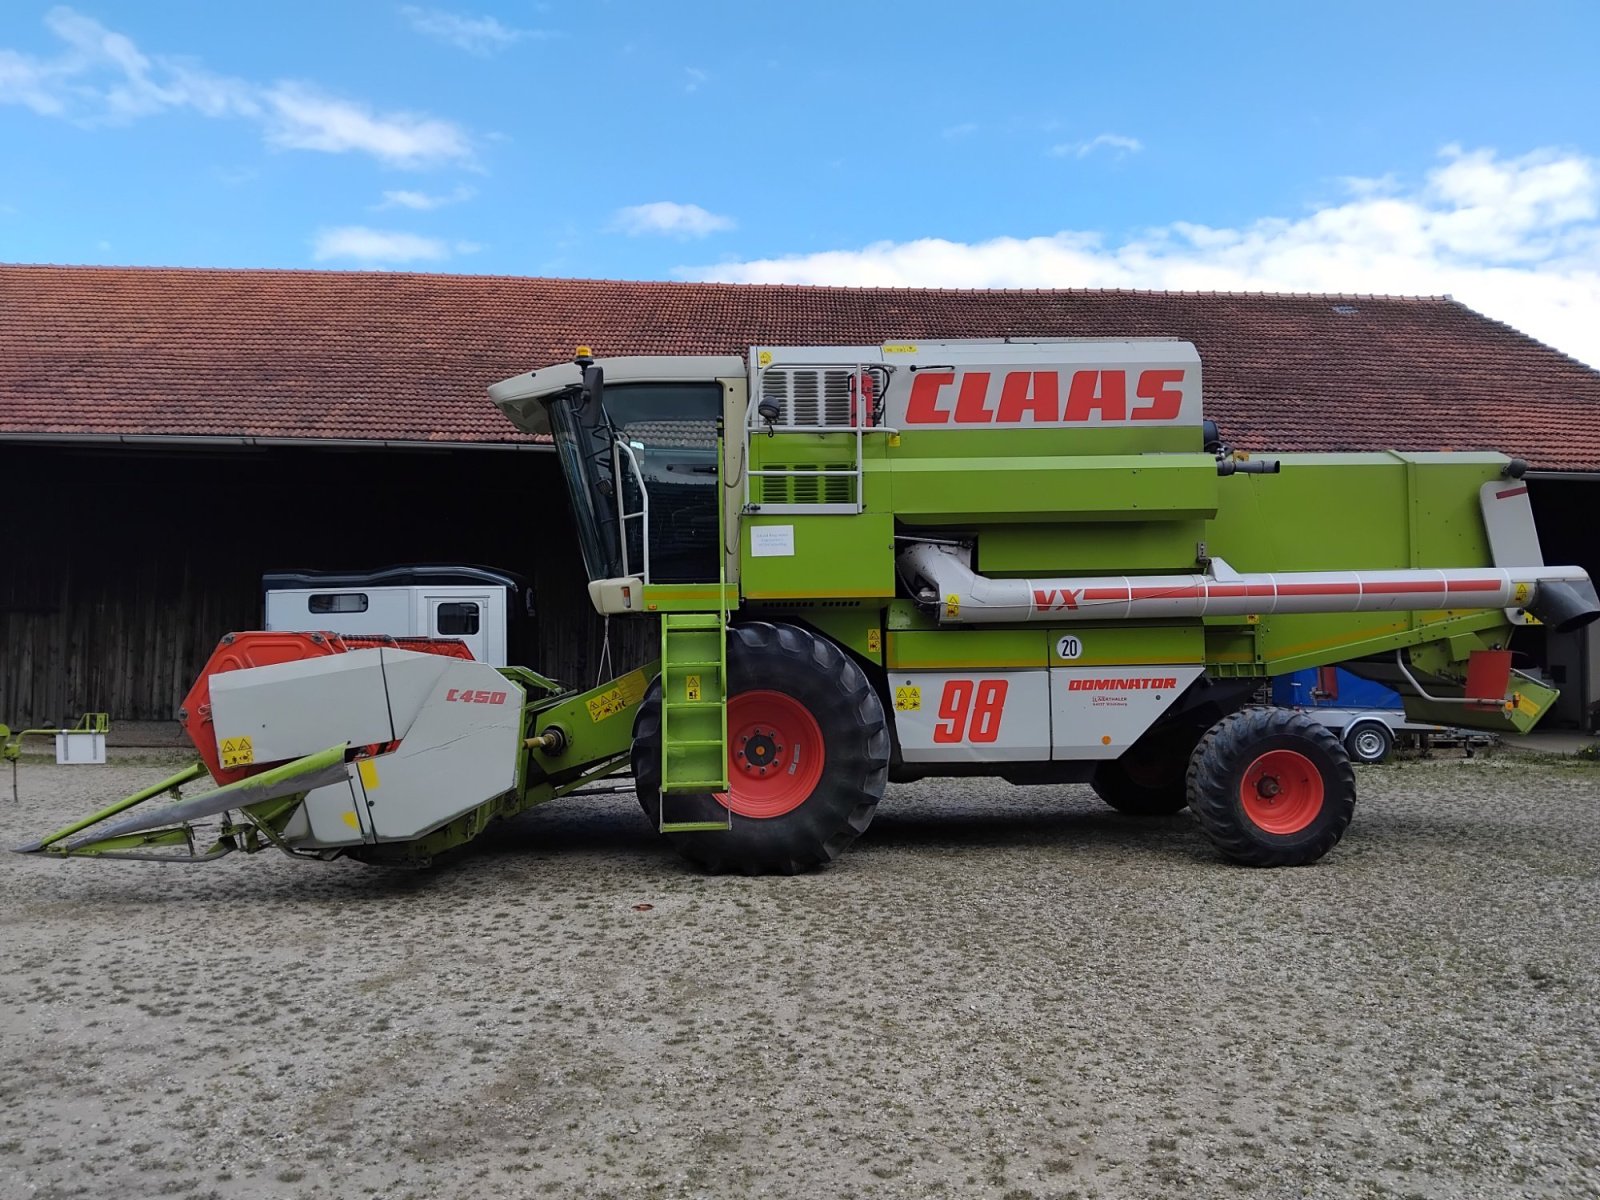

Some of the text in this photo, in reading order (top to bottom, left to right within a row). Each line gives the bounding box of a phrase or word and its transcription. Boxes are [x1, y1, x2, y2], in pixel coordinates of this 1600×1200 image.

[905, 370, 1185, 423] CLAAS
[1034, 589, 1083, 611] VX
[1062, 640, 1078, 656] 20
[1068, 678, 1177, 691] DOMINATOR
[446, 689, 507, 704] C450
[933, 680, 1009, 743] 98
